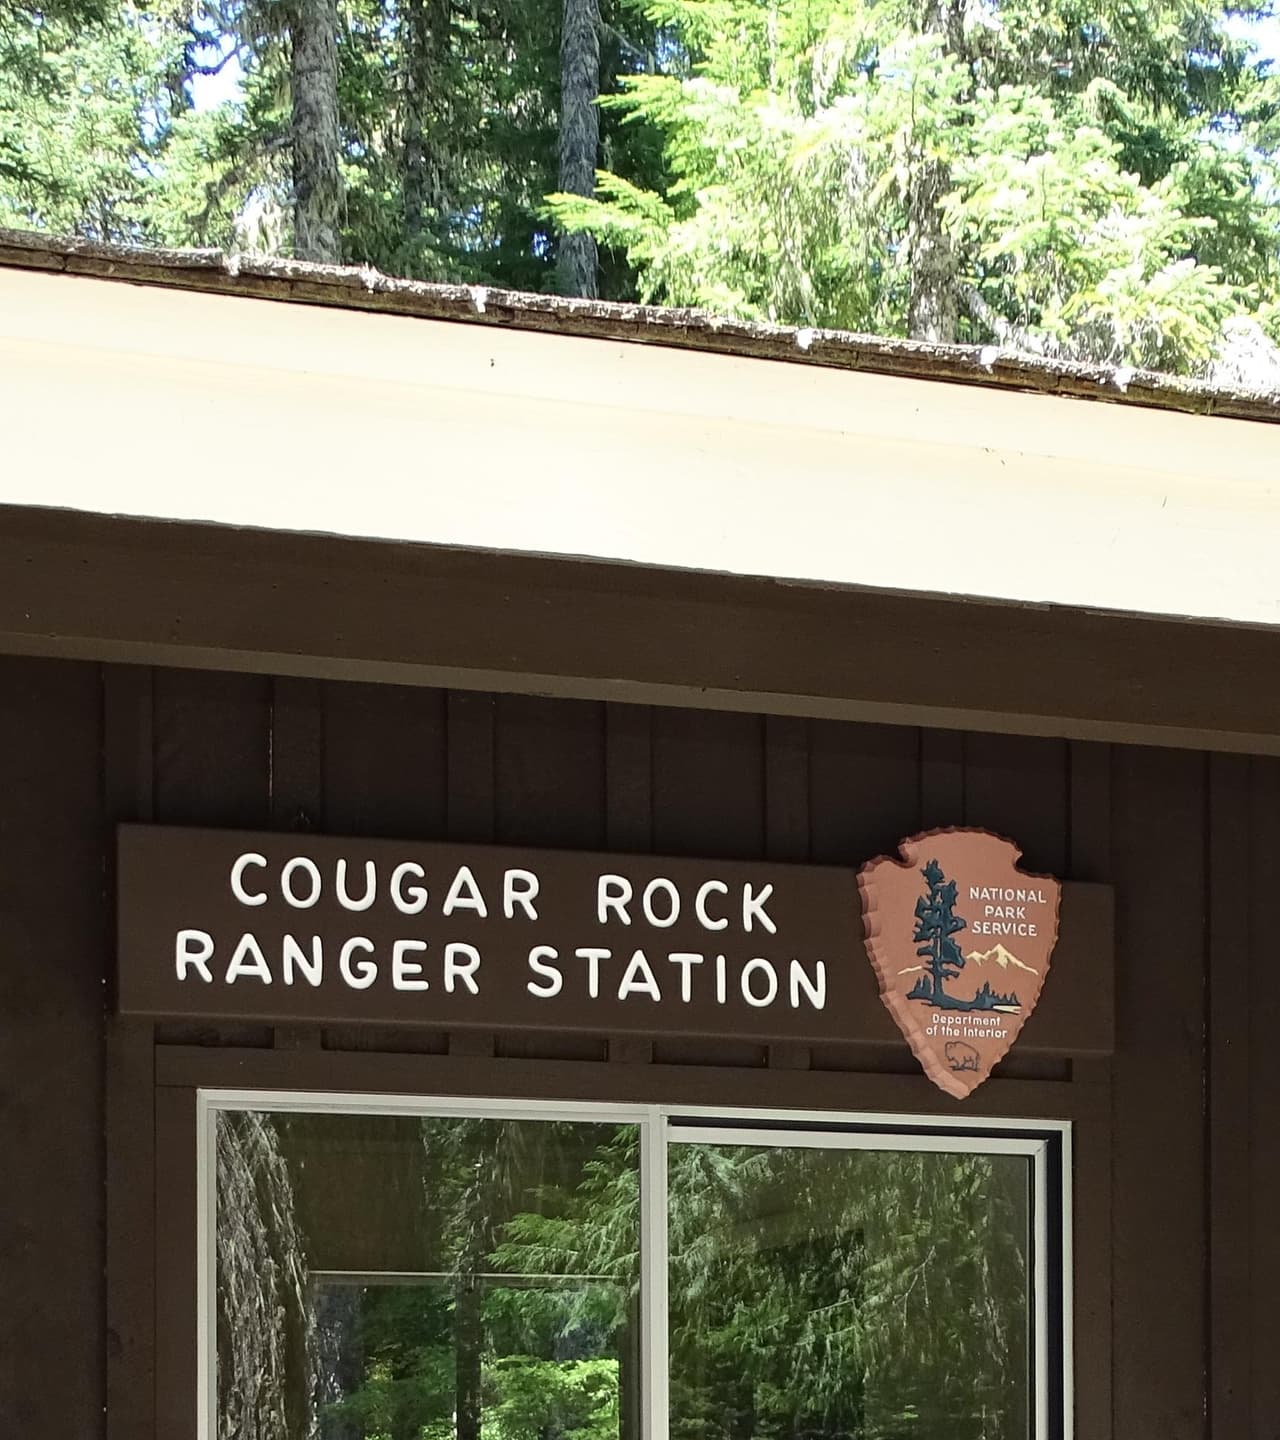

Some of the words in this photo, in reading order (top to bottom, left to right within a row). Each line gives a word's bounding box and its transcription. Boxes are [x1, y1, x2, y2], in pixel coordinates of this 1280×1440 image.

[228, 851, 542, 923] COUGAR
[595, 872, 780, 936] ROCK
[969, 886, 1047, 904] NATIONAL
[984, 904, 1027, 920] PARK
[971, 920, 1038, 937] SERVICE
[173, 927, 483, 997] RANGER
[525, 943, 828, 1012] STATION
[932, 1012, 1001, 1027] Department
[926, 1023, 938, 1036] of
[941, 1025, 961, 1038] the
[963, 1026, 1009, 1039] Interior
